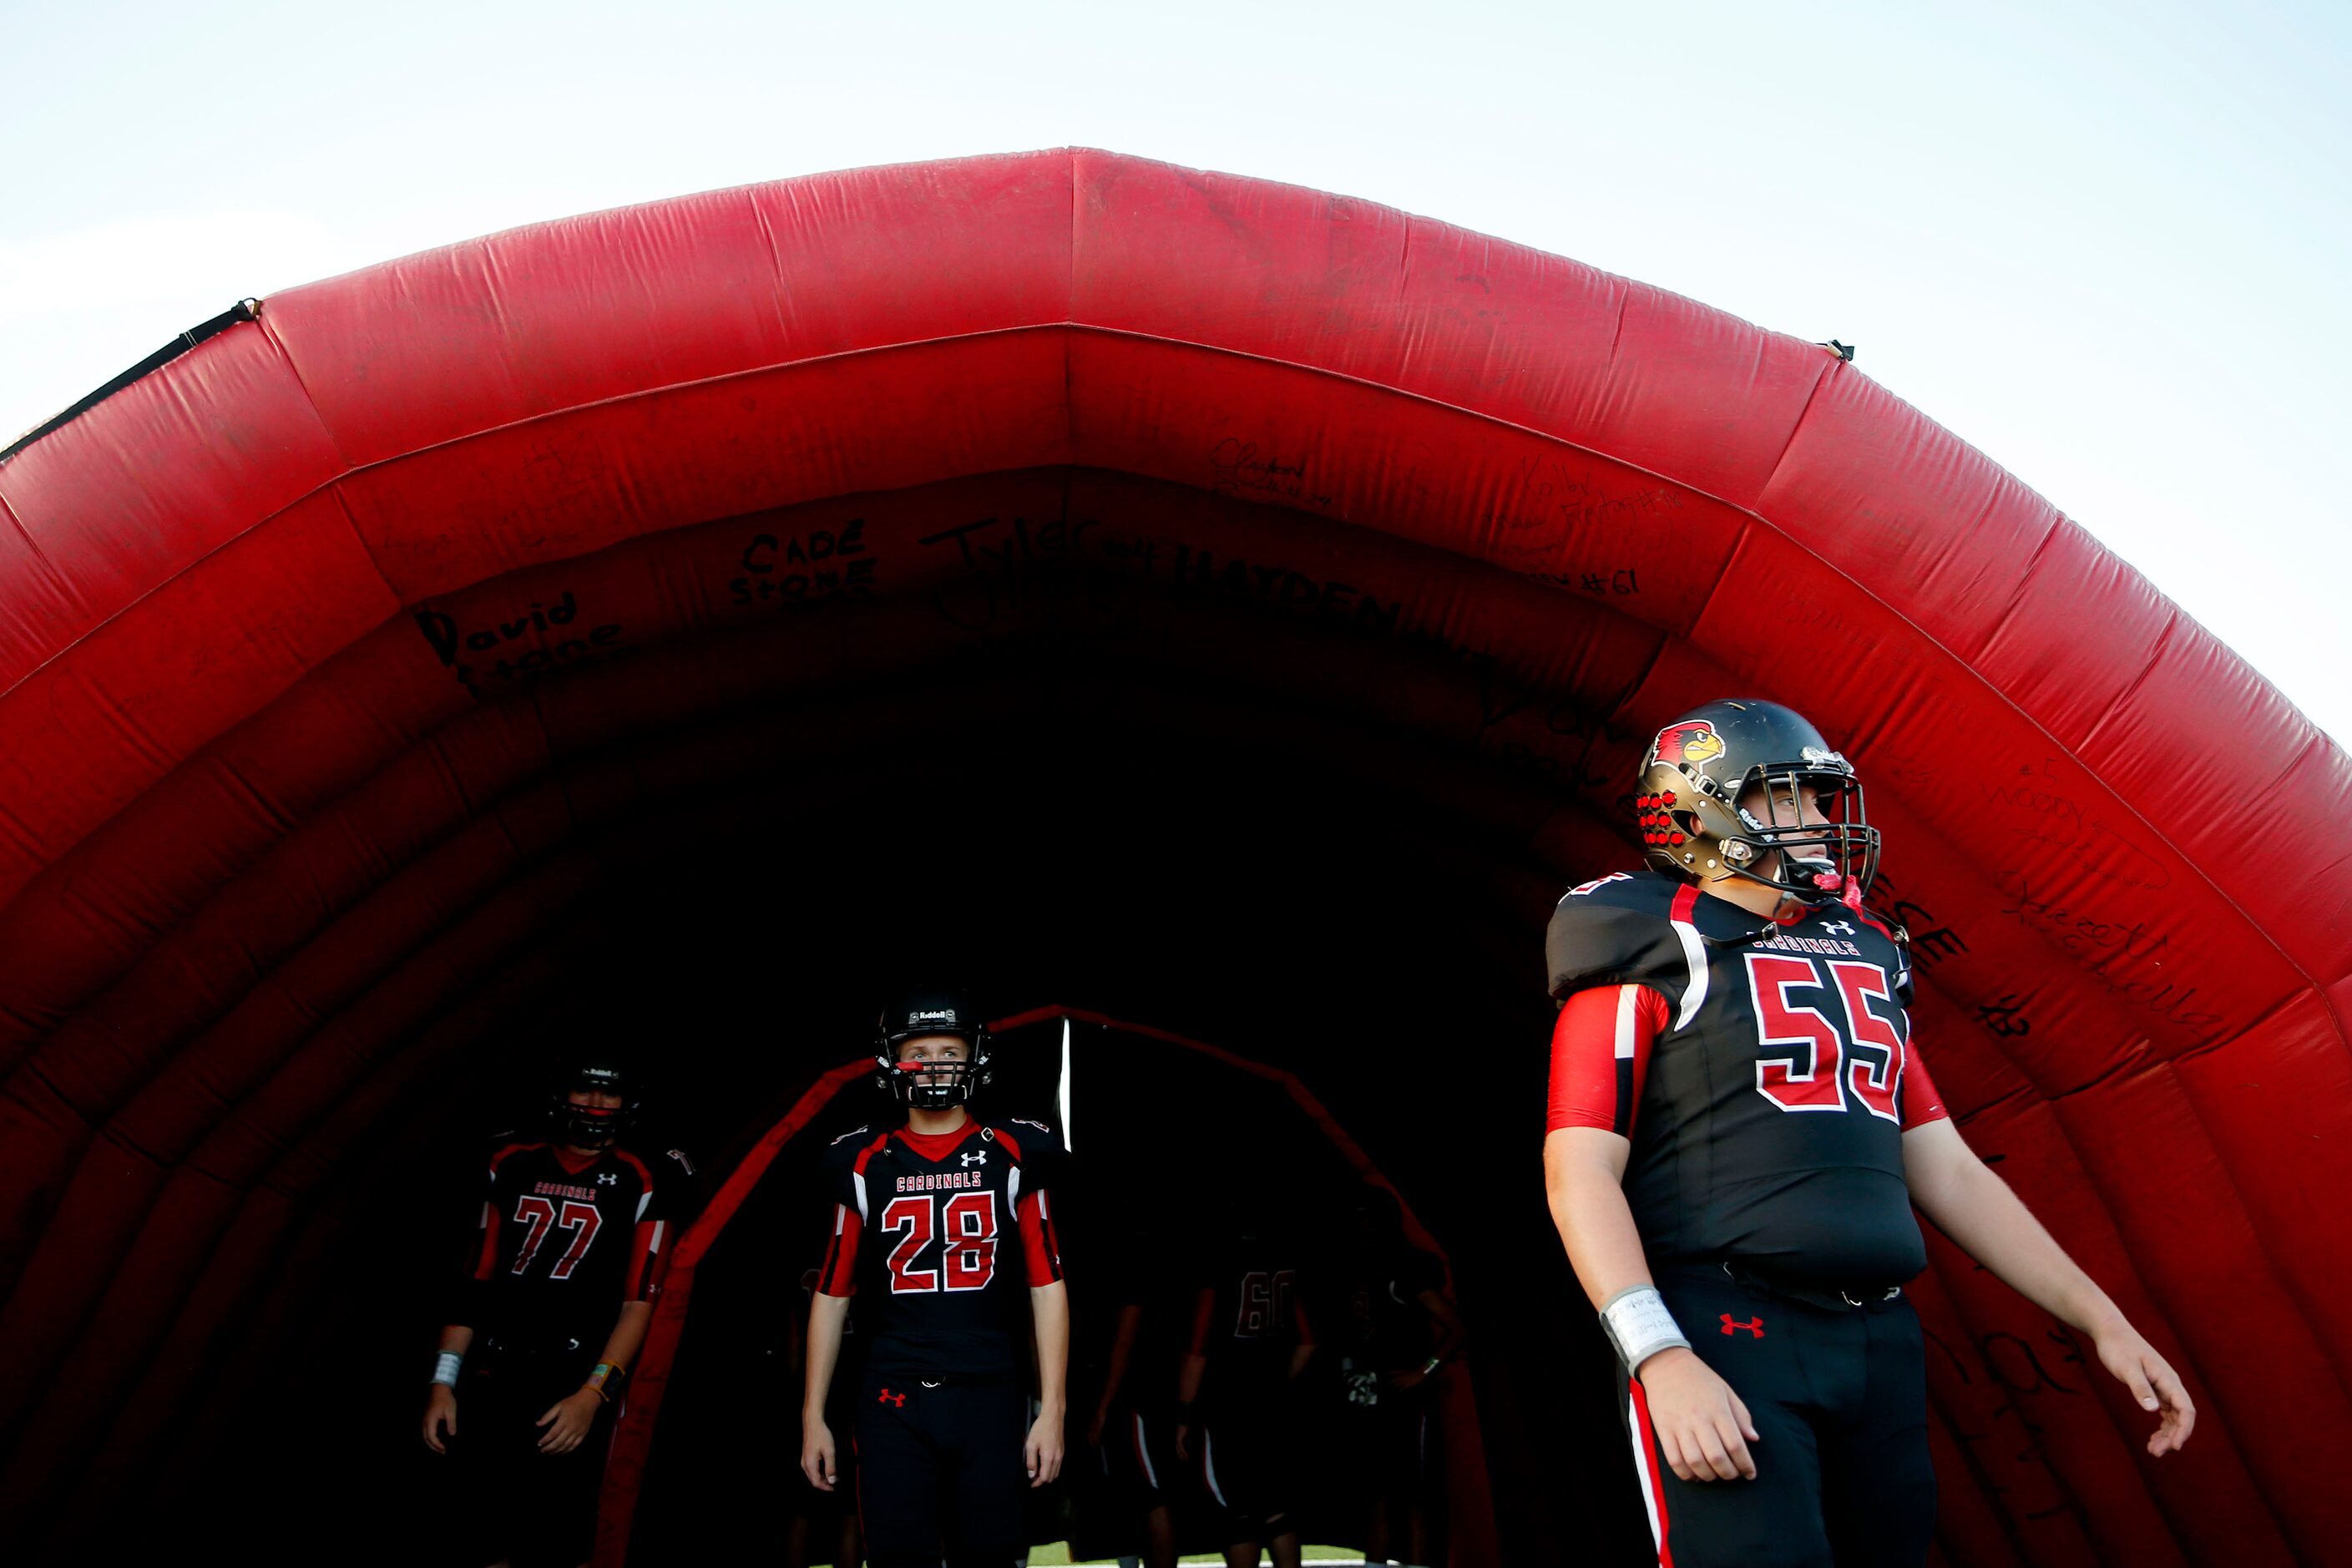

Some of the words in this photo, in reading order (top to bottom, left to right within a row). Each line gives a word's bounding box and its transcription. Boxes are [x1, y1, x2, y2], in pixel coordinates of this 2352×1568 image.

[743, 518, 866, 574] CADE
[919, 516, 1101, 576] Tyler
[1176, 543, 1404, 630] HAYDEN
[1581, 569, 1639, 594] #61
[414, 589, 579, 666] David
[1743, 953, 1905, 1125] 55
[534, 1181, 597, 1201] CARDINALS
[896, 1171, 982, 1192] CARDINALS
[513, 1195, 604, 1281] 77
[881, 1190, 999, 1295] 28
